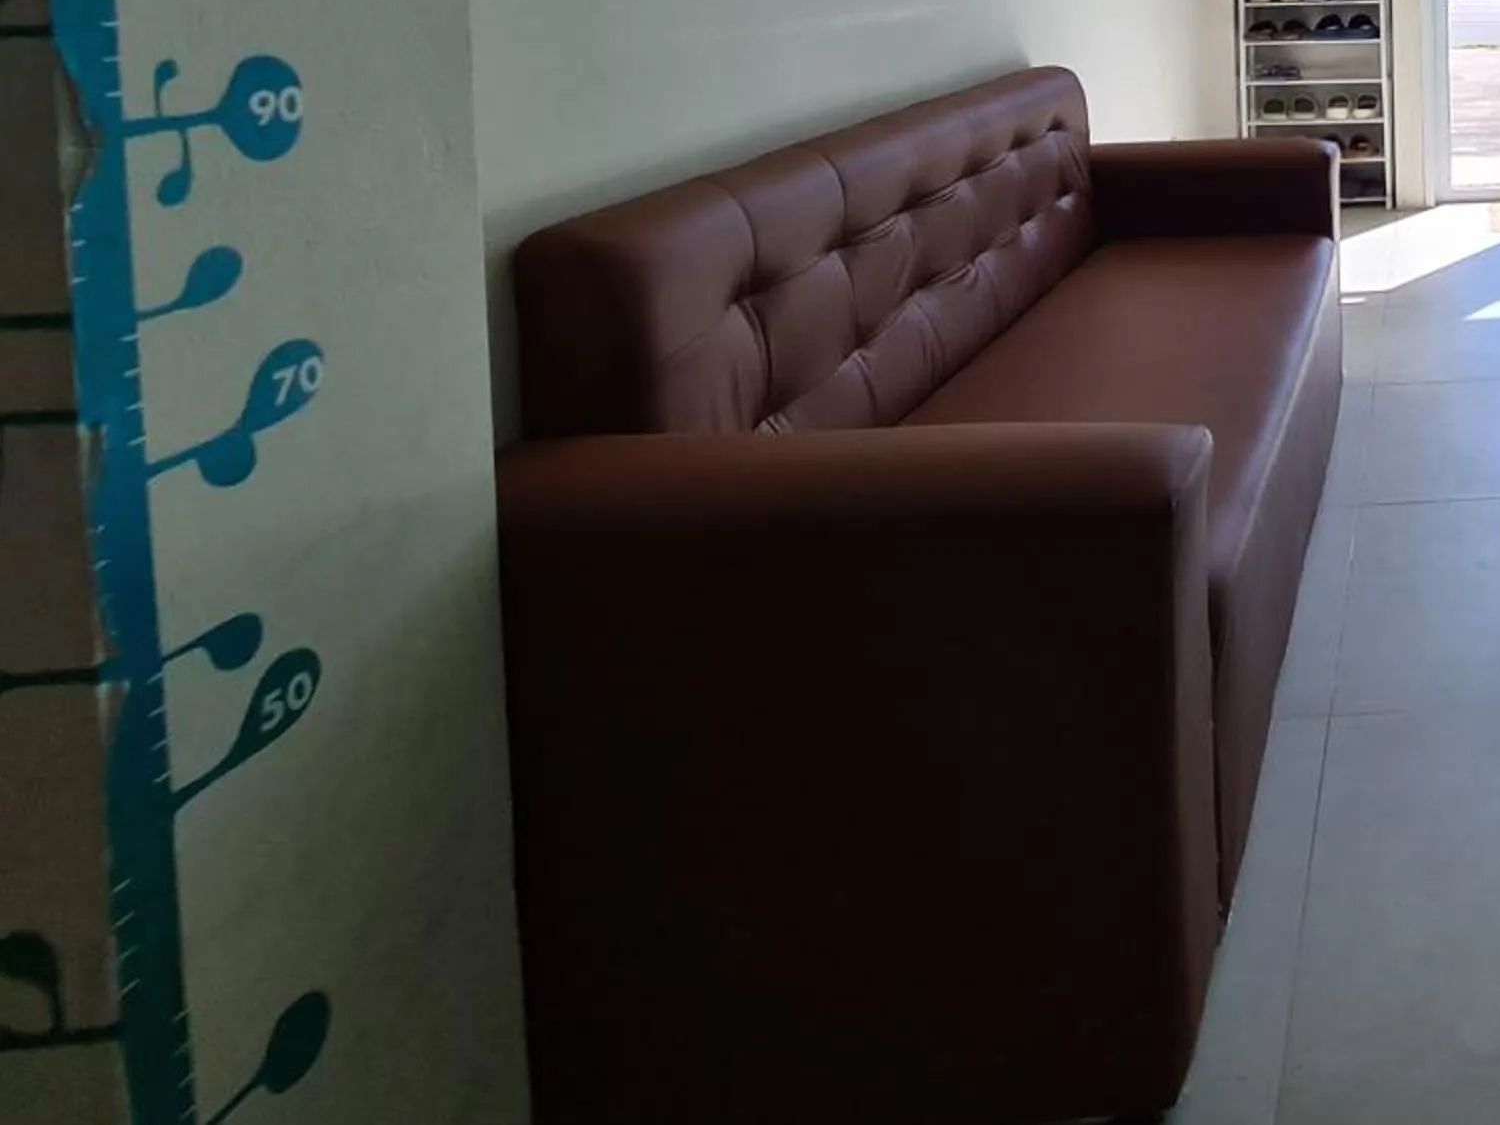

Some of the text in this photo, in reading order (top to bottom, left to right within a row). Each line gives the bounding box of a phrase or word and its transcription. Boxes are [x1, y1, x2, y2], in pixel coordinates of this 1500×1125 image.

[249, 87, 302, 126] 90
[272, 356, 323, 407] 70
[260, 674, 312, 731] 50
